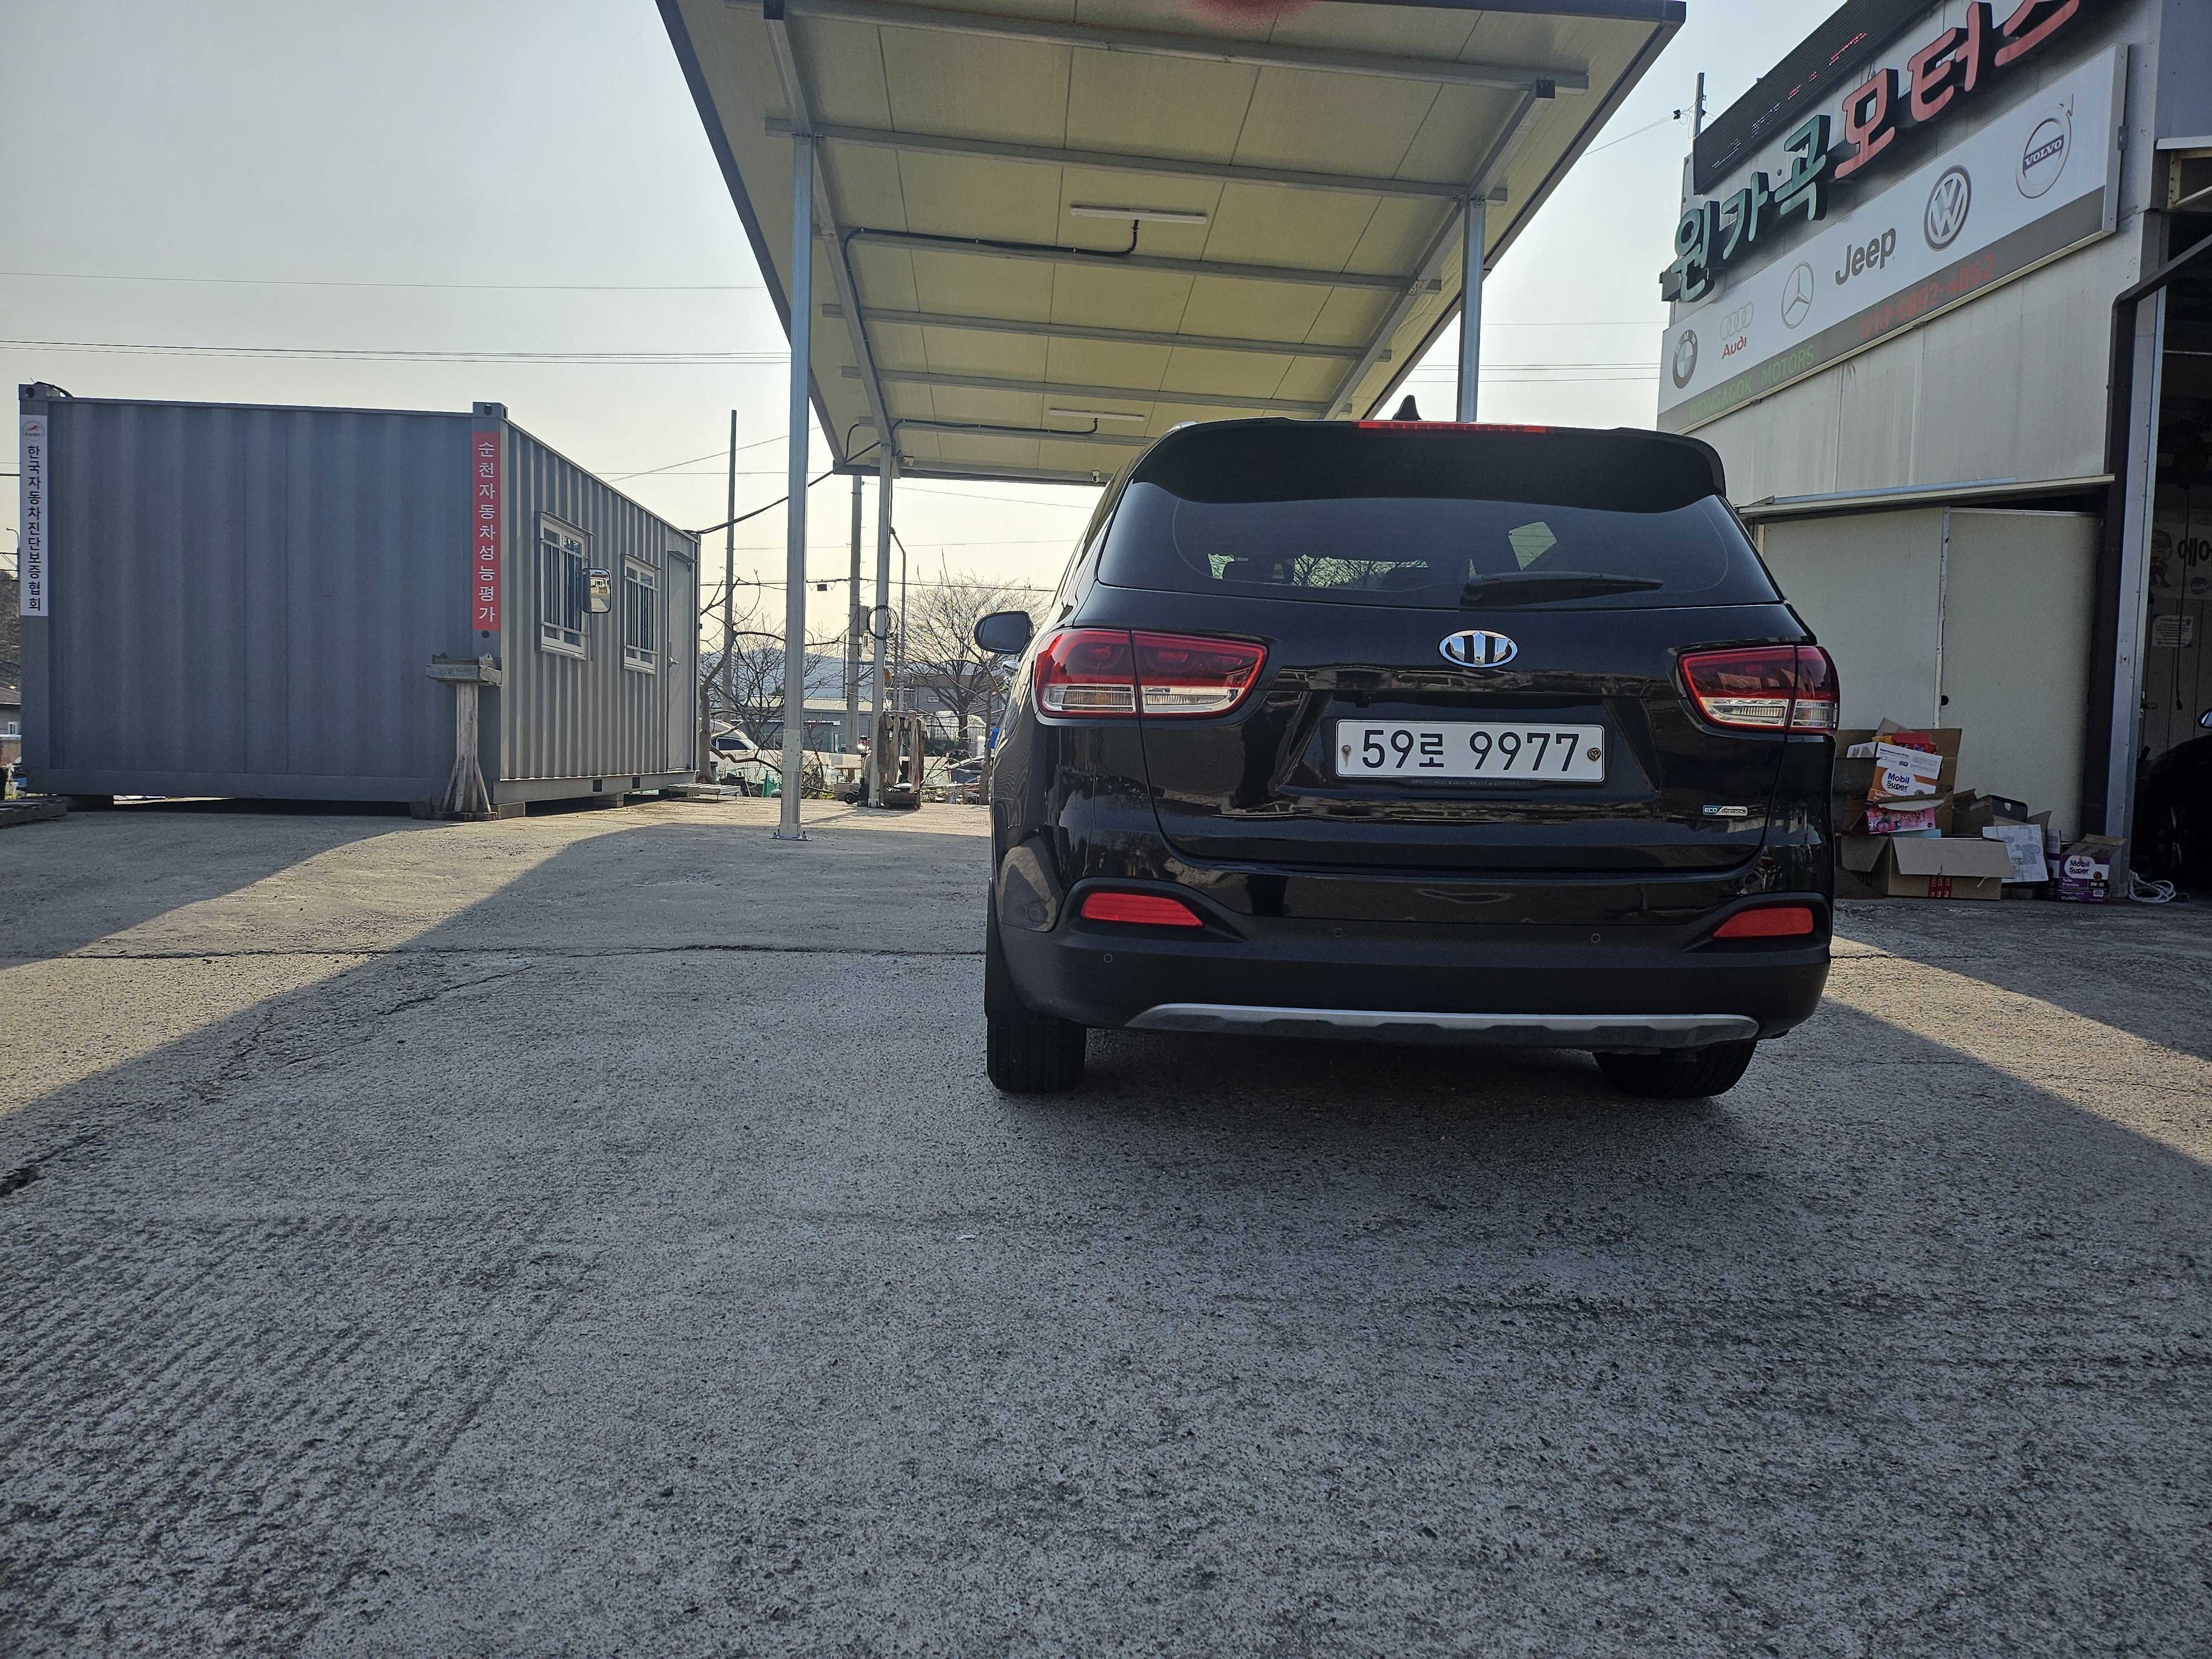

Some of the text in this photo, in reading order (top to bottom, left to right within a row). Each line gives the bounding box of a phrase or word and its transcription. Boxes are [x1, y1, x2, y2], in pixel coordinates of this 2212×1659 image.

[2023, 139, 2062, 165] VOLVO
[1835, 228, 1896, 285] Jeep
[1721, 336, 1747, 359] Audi
[1688, 344, 1814, 420] WONGAGOK MOTORS
[28, 445, 41, 611] 한국자동차진단보증협회
[478, 441, 495, 622] 순천자동차성능평가
[1362, 729, 1579, 771] 59로 9977
[1886, 780, 1908, 791] Super
[1887, 773, 1910, 784] Mobil
